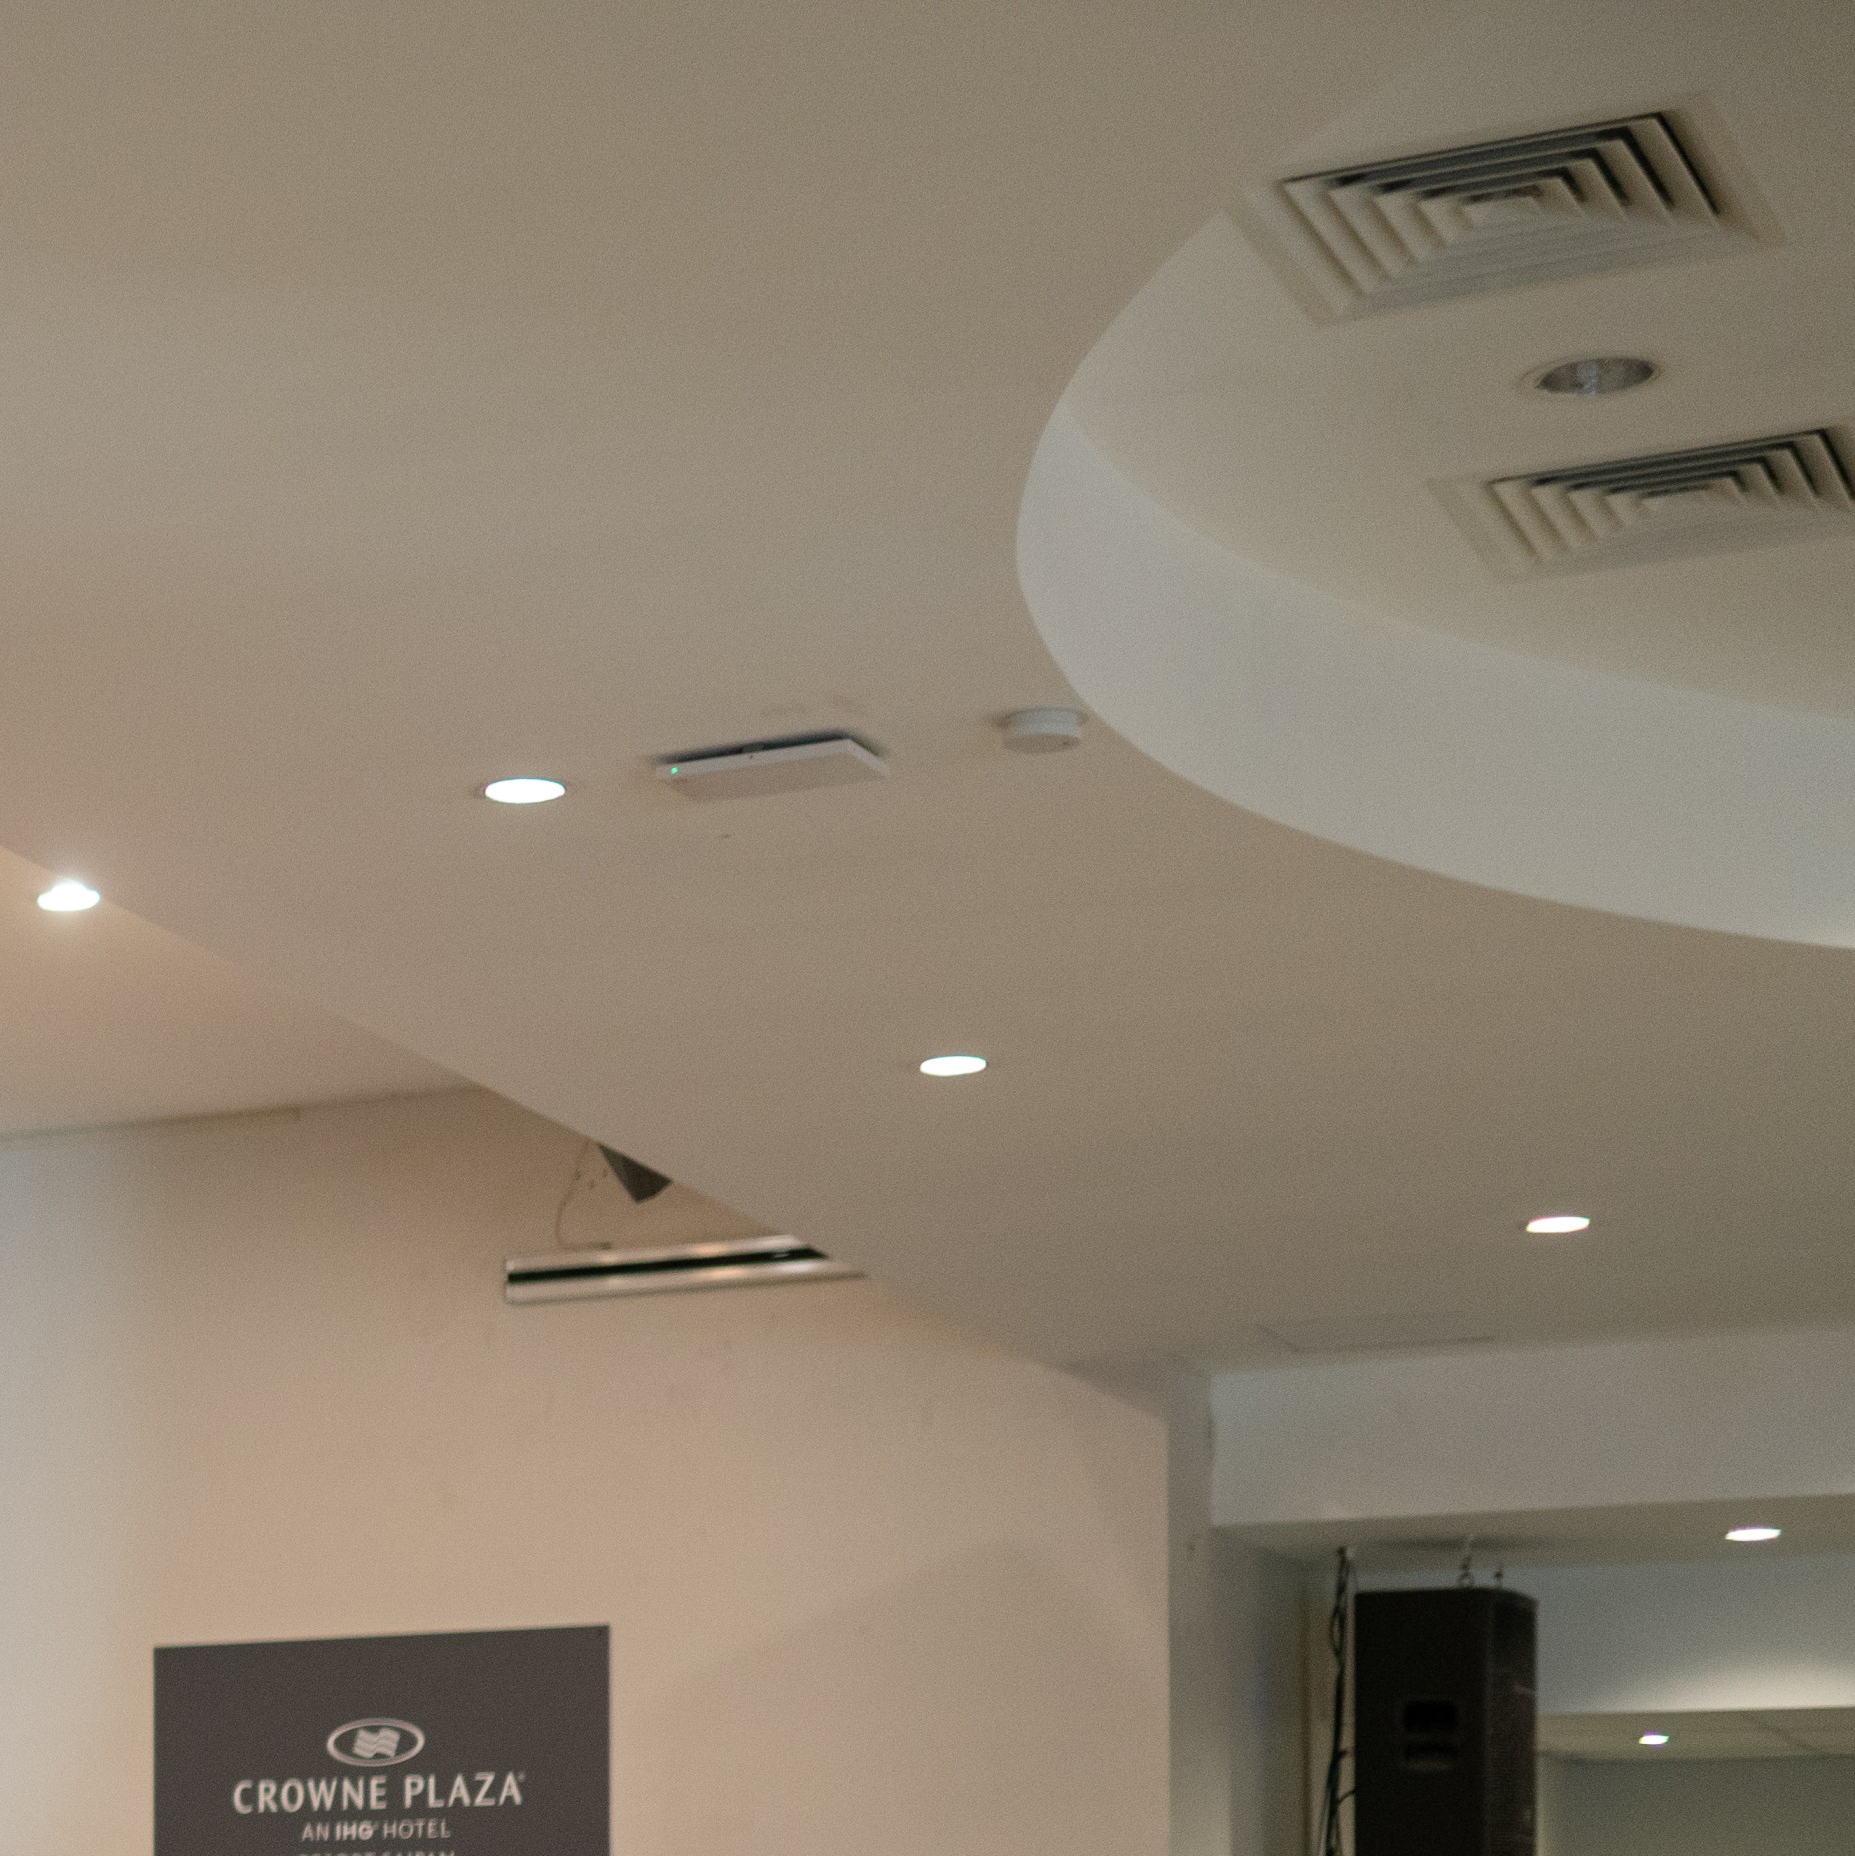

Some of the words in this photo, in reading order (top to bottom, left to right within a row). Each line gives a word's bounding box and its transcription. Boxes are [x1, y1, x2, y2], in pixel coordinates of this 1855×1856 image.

[233, 1775, 387, 1814] CROWNE
[301, 1822, 329, 1841] AN
[383, 1818, 451, 1839] HOTEL
